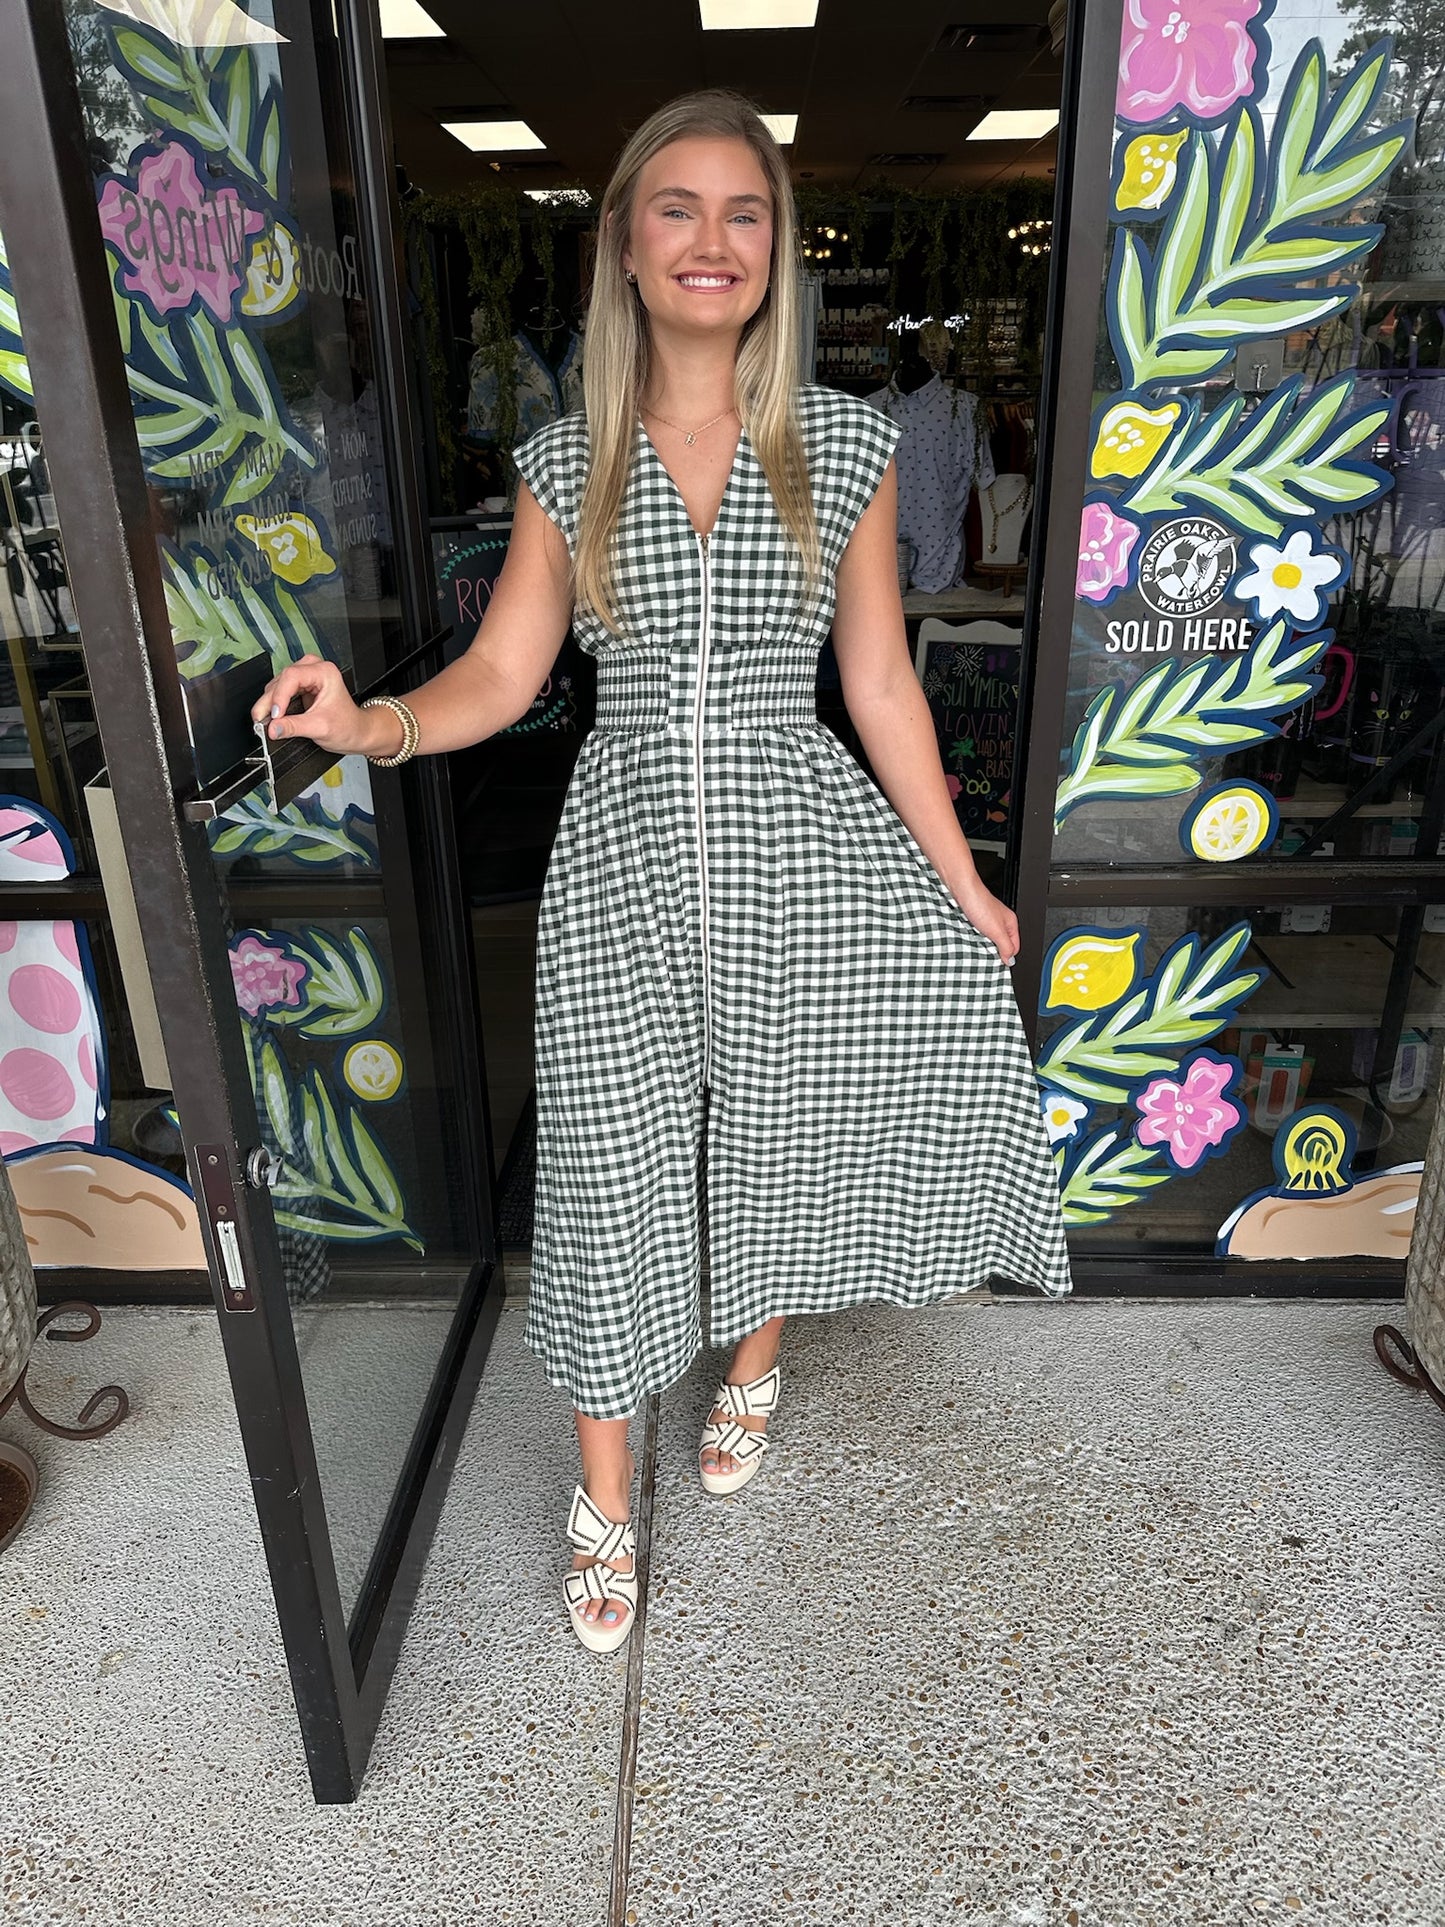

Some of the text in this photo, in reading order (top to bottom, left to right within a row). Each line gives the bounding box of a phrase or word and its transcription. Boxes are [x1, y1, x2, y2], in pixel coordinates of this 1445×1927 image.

[1142, 523, 1221, 583] PRAIRIE OAKS
[1156, 565, 1231, 612] WATERFOWL
[1105, 618, 1252, 653] SOLD HERE
[943, 671, 1010, 708] SUMMER
[976, 740, 996, 757] HAD
